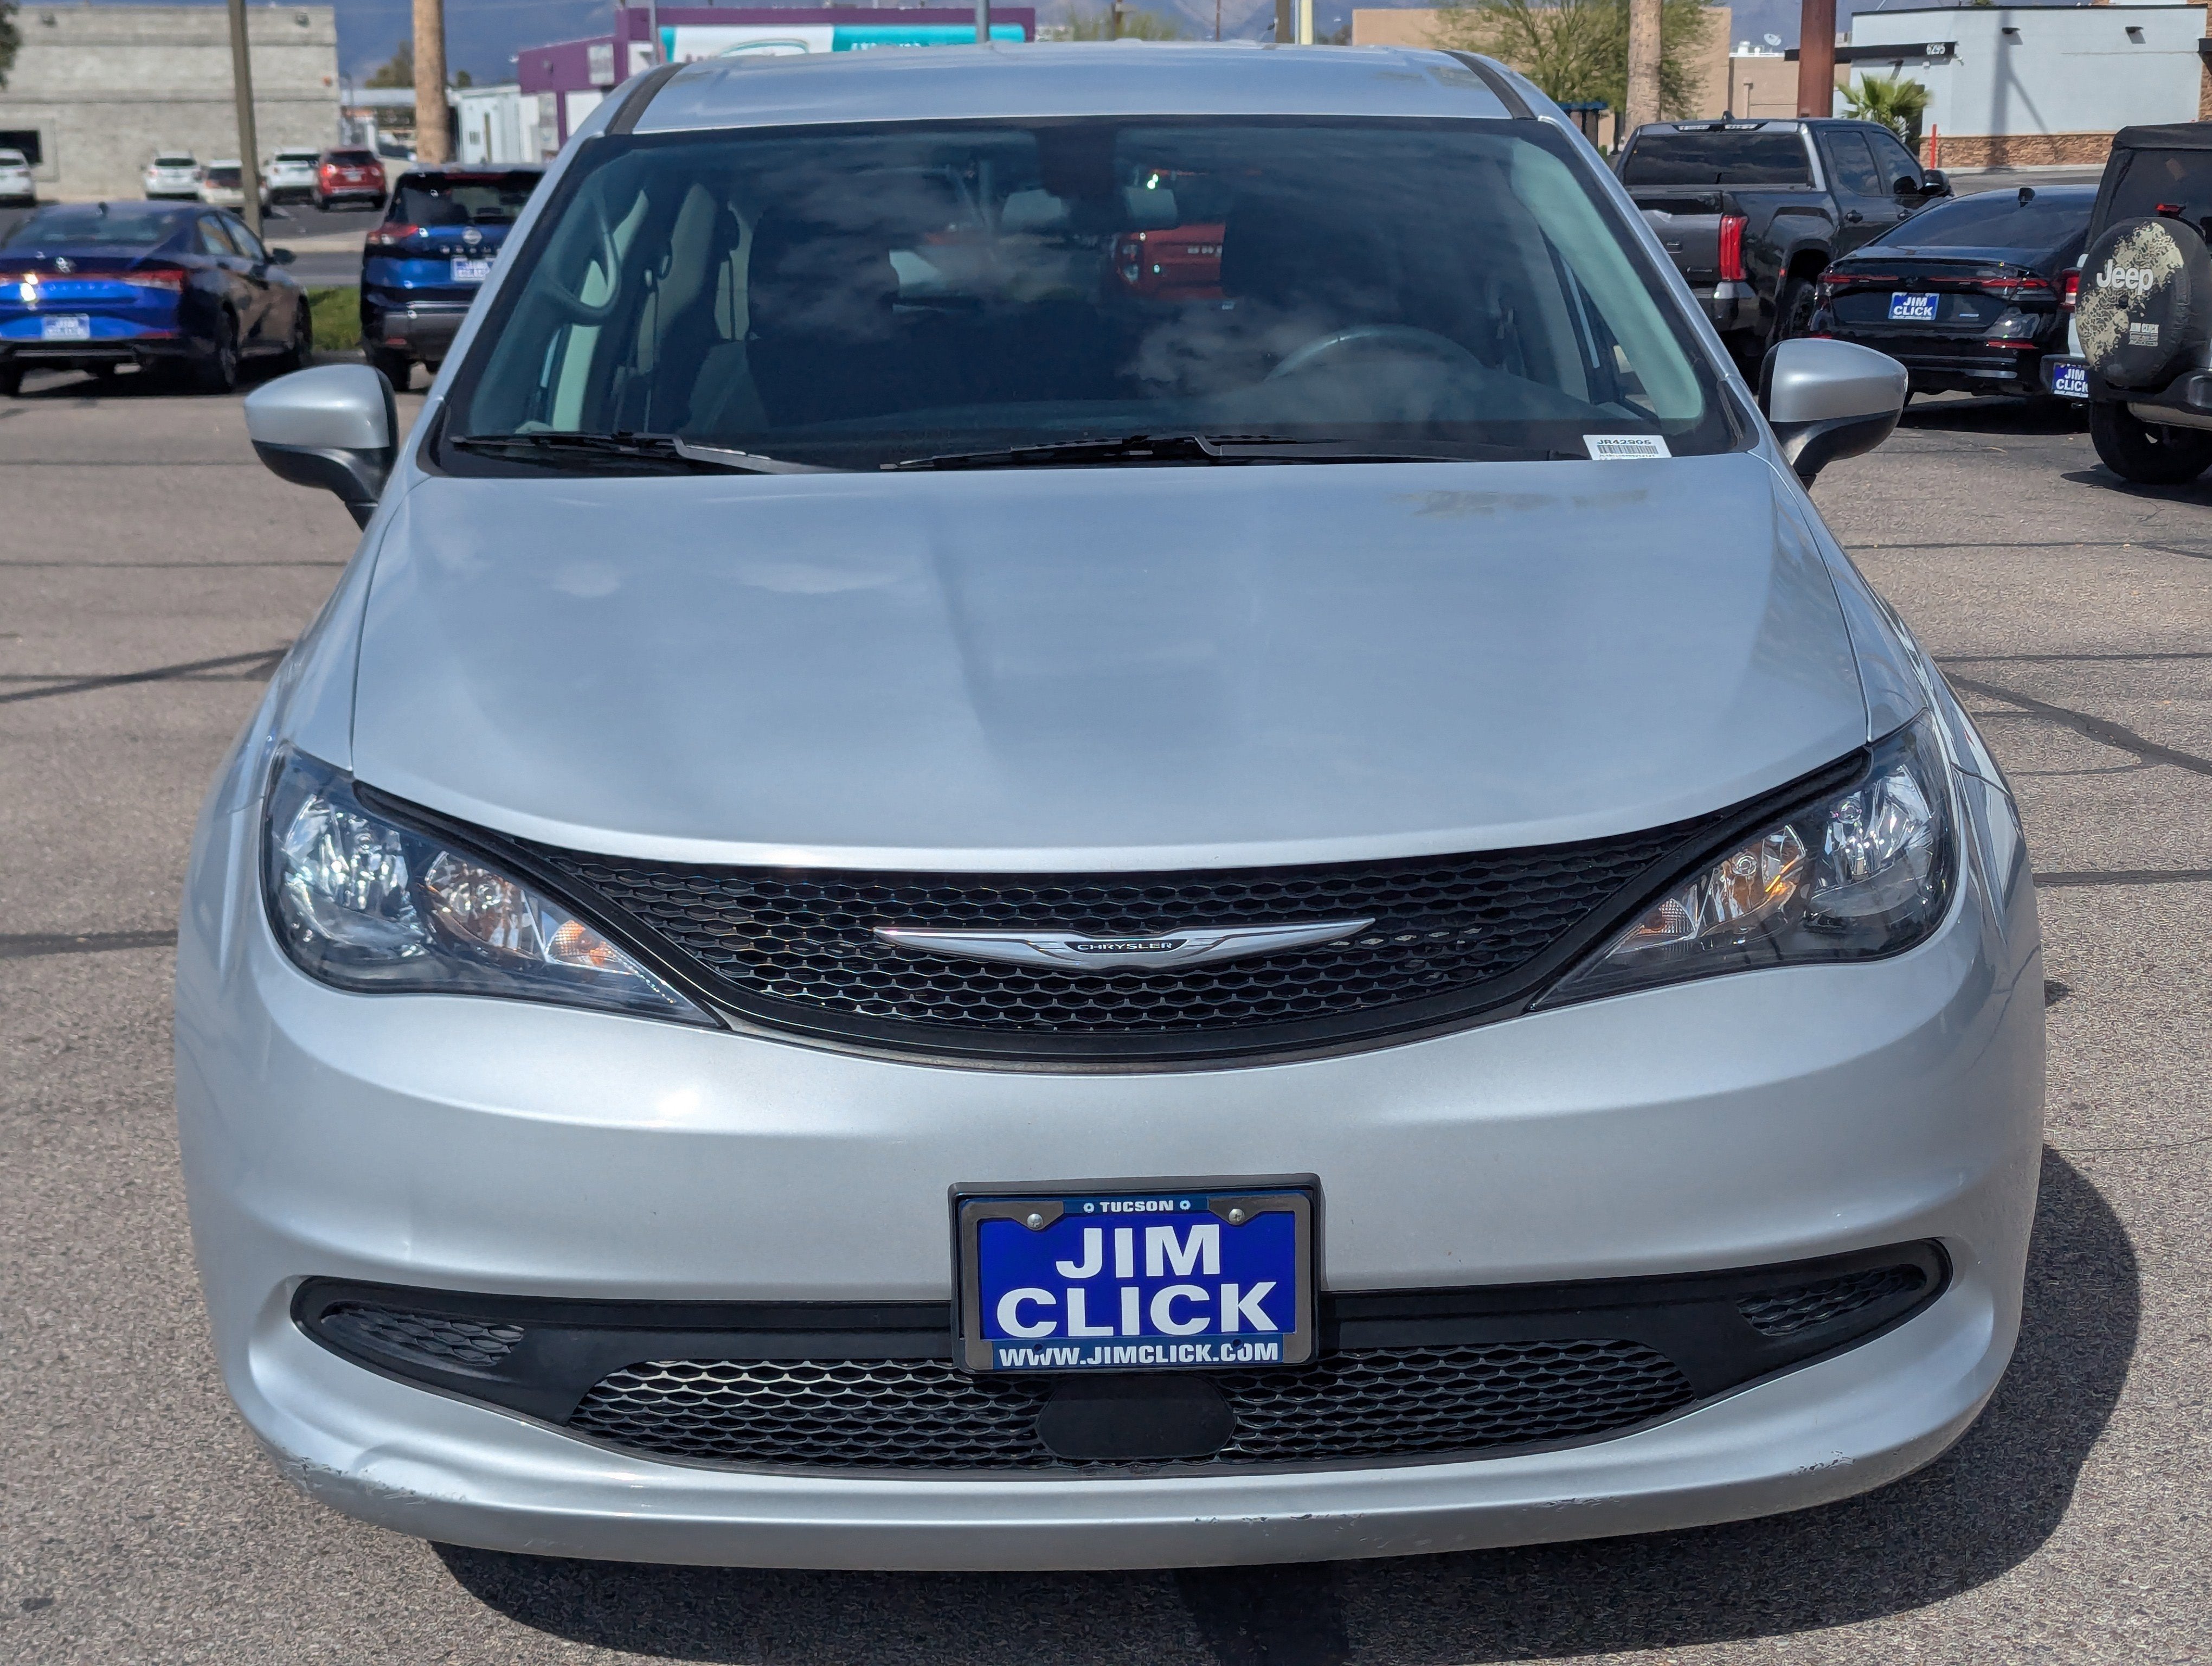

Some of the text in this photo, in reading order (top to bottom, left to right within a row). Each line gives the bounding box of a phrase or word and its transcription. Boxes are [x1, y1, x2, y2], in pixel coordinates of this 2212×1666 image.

[1926, 43, 1946, 55] 6295
[2096, 259, 2153, 296] Jeep
[1903, 297, 1927, 307] JIM
[1893, 305, 1933, 316] CLICK
[2064, 368, 2085, 381] JIM
[1077, 942, 1172, 950] CHRYSLER
[1099, 1200, 1174, 1213] TUCSON
[1056, 1224, 1220, 1279] JIM
[996, 1281, 1278, 1338] CLICK
[999, 1343, 1278, 1367] WWW.JIMCLICK.COM
